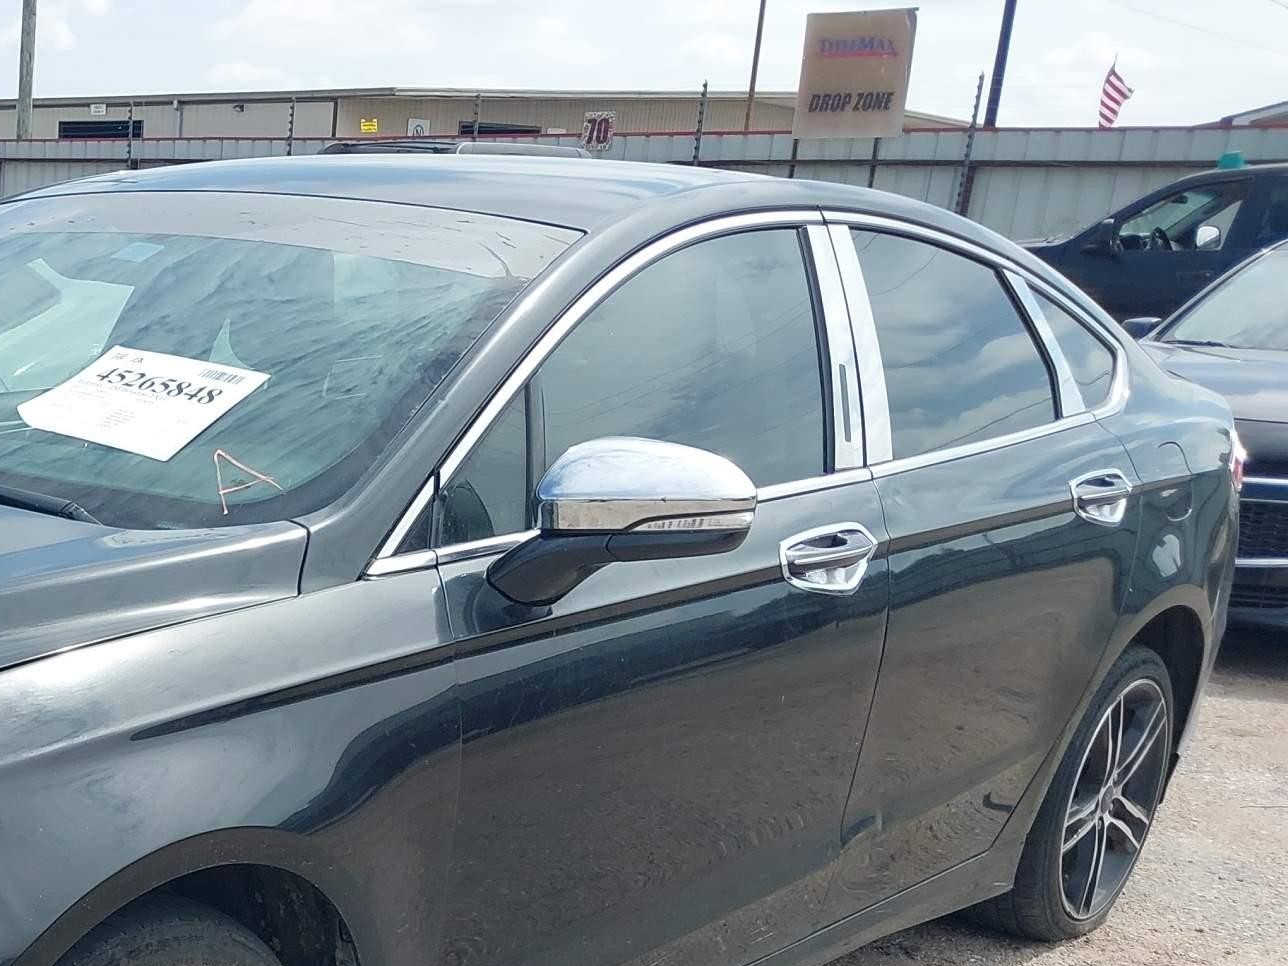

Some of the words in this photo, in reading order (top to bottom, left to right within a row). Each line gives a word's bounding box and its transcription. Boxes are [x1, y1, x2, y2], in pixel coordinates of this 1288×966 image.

[809, 93, 852, 112] DROP
[853, 91, 894, 111] ZONE
[586, 118, 610, 144] 70
[96, 367, 223, 405] 45265848
[214, 449, 283, 515] A
